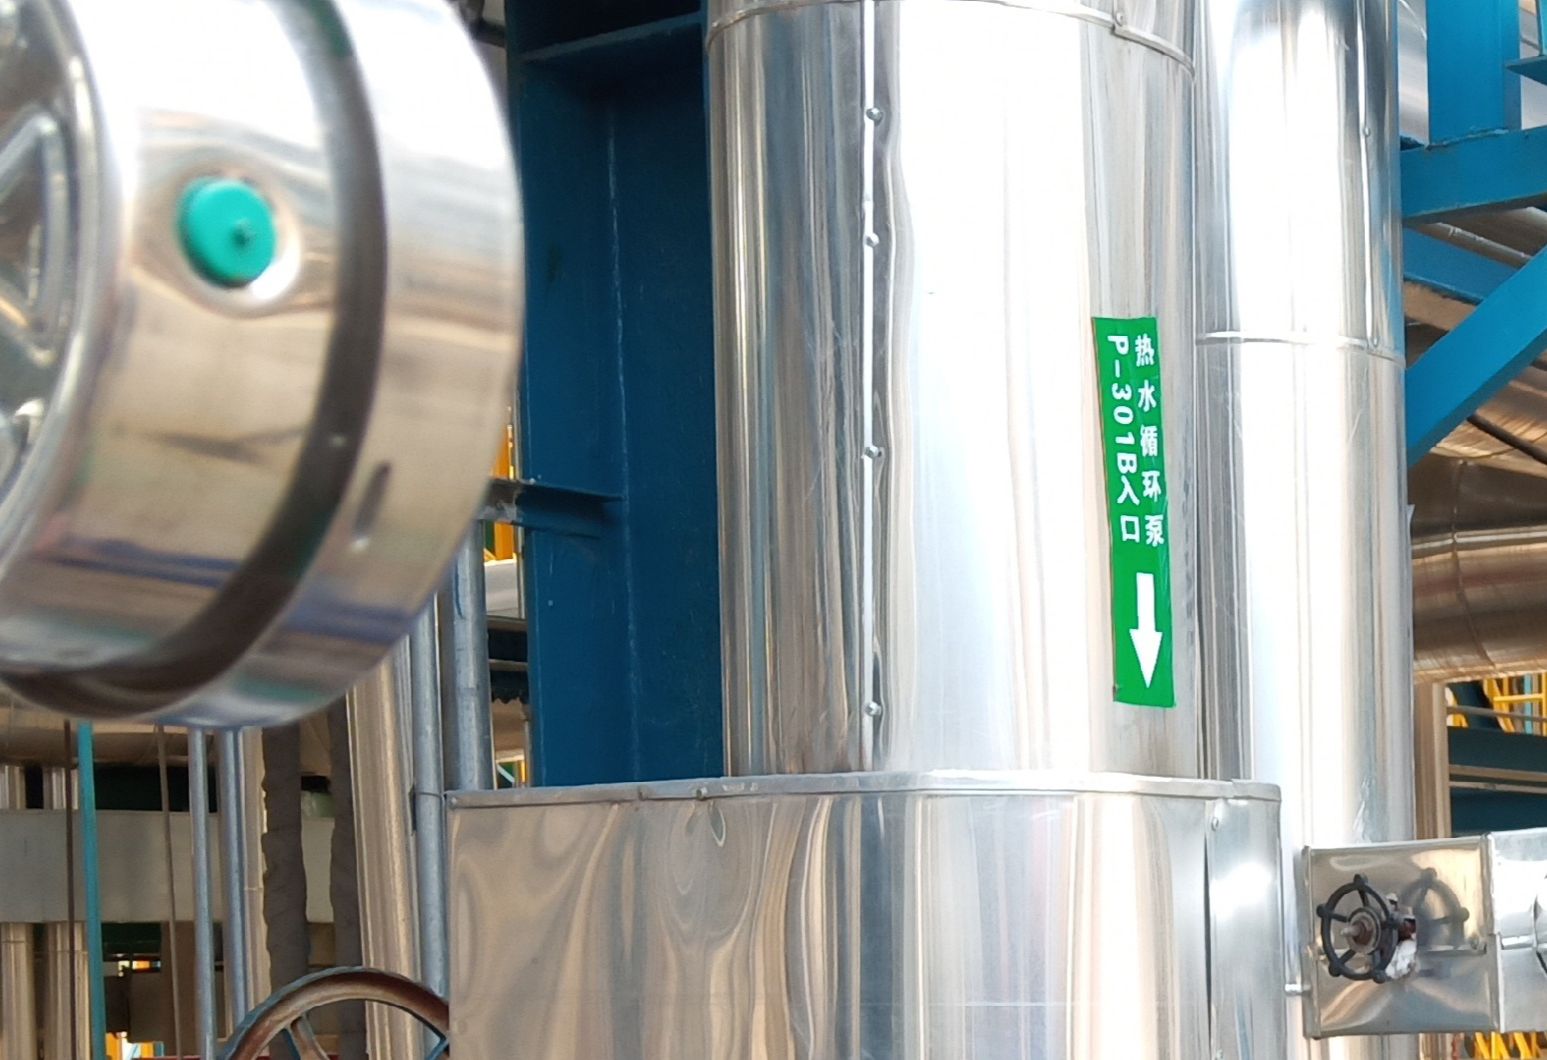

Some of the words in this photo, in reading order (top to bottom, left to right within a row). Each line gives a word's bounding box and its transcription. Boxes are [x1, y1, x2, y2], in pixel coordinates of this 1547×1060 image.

[1107, 334, 1140, 543] P-301B入口
[1134, 333, 1165, 547] 热水循环泵
